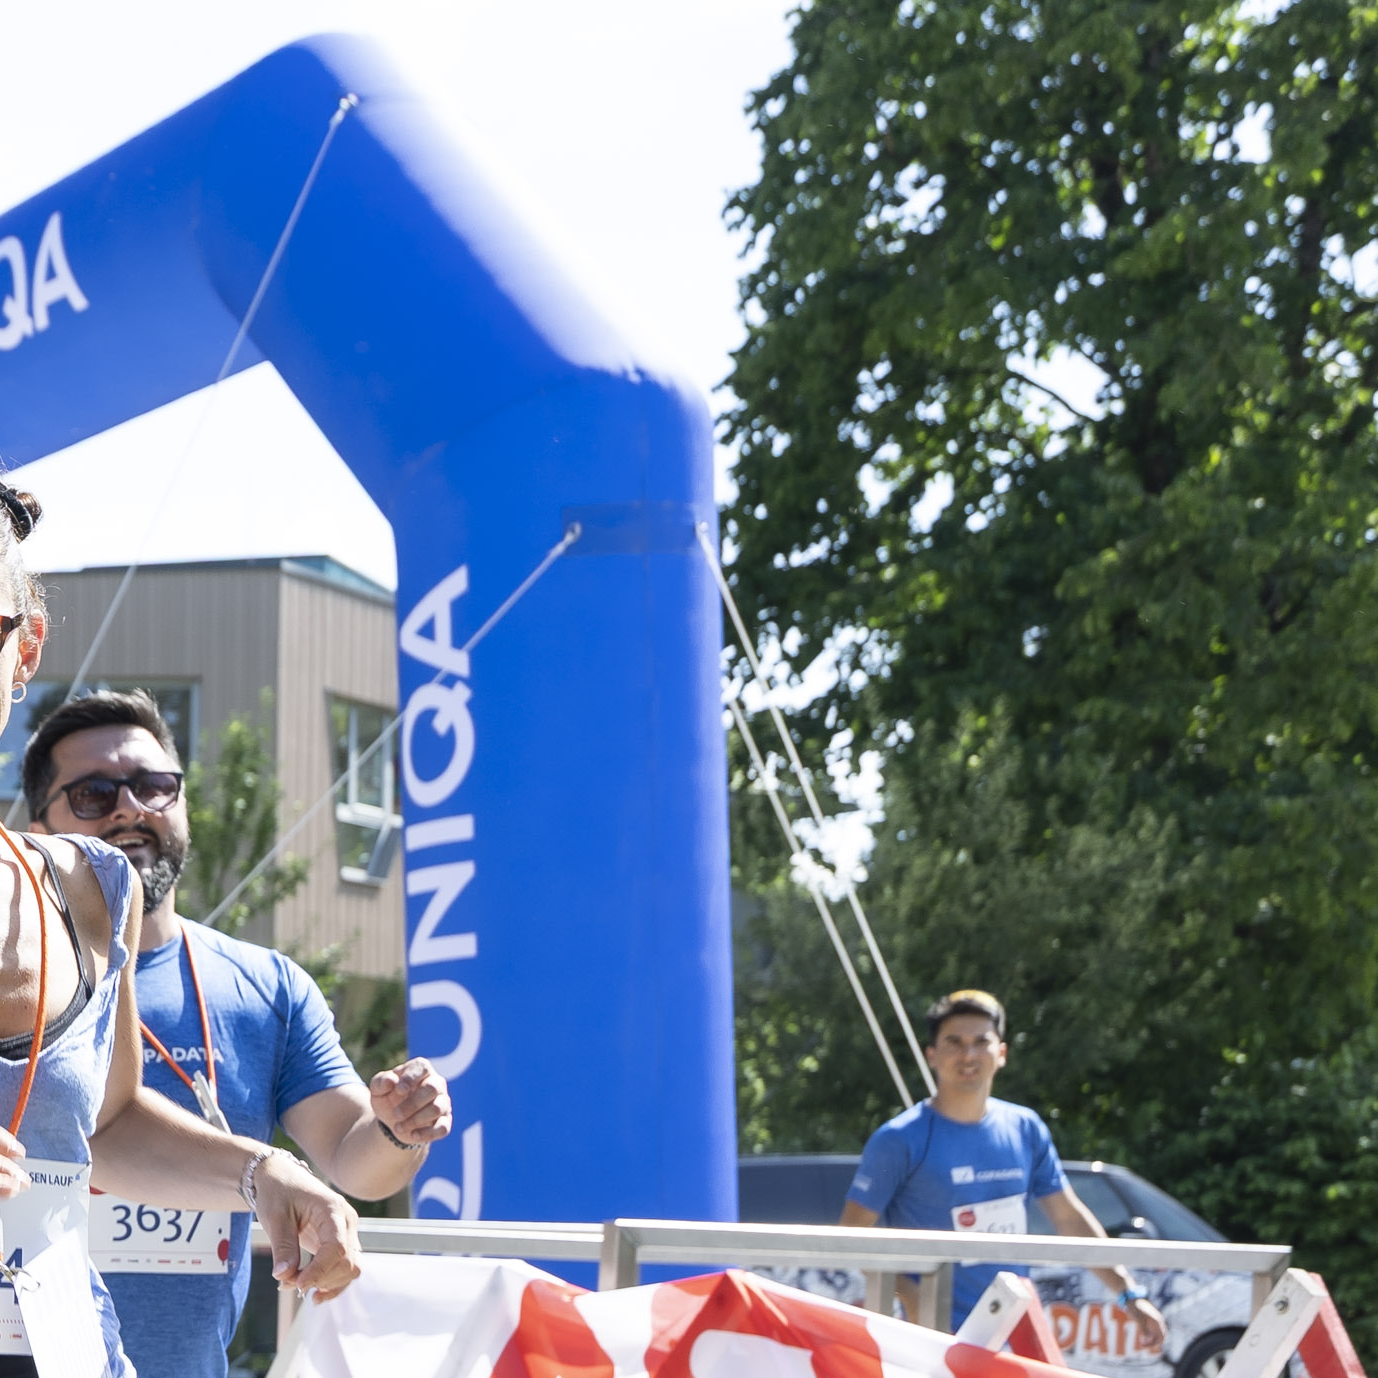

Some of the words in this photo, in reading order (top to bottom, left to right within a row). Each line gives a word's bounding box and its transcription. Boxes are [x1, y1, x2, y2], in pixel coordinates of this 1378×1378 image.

[399, 563, 483, 1084] UNIQA
[48, 1174, 74, 1188] LAUF
[111, 1203, 205, 1243] 3637
